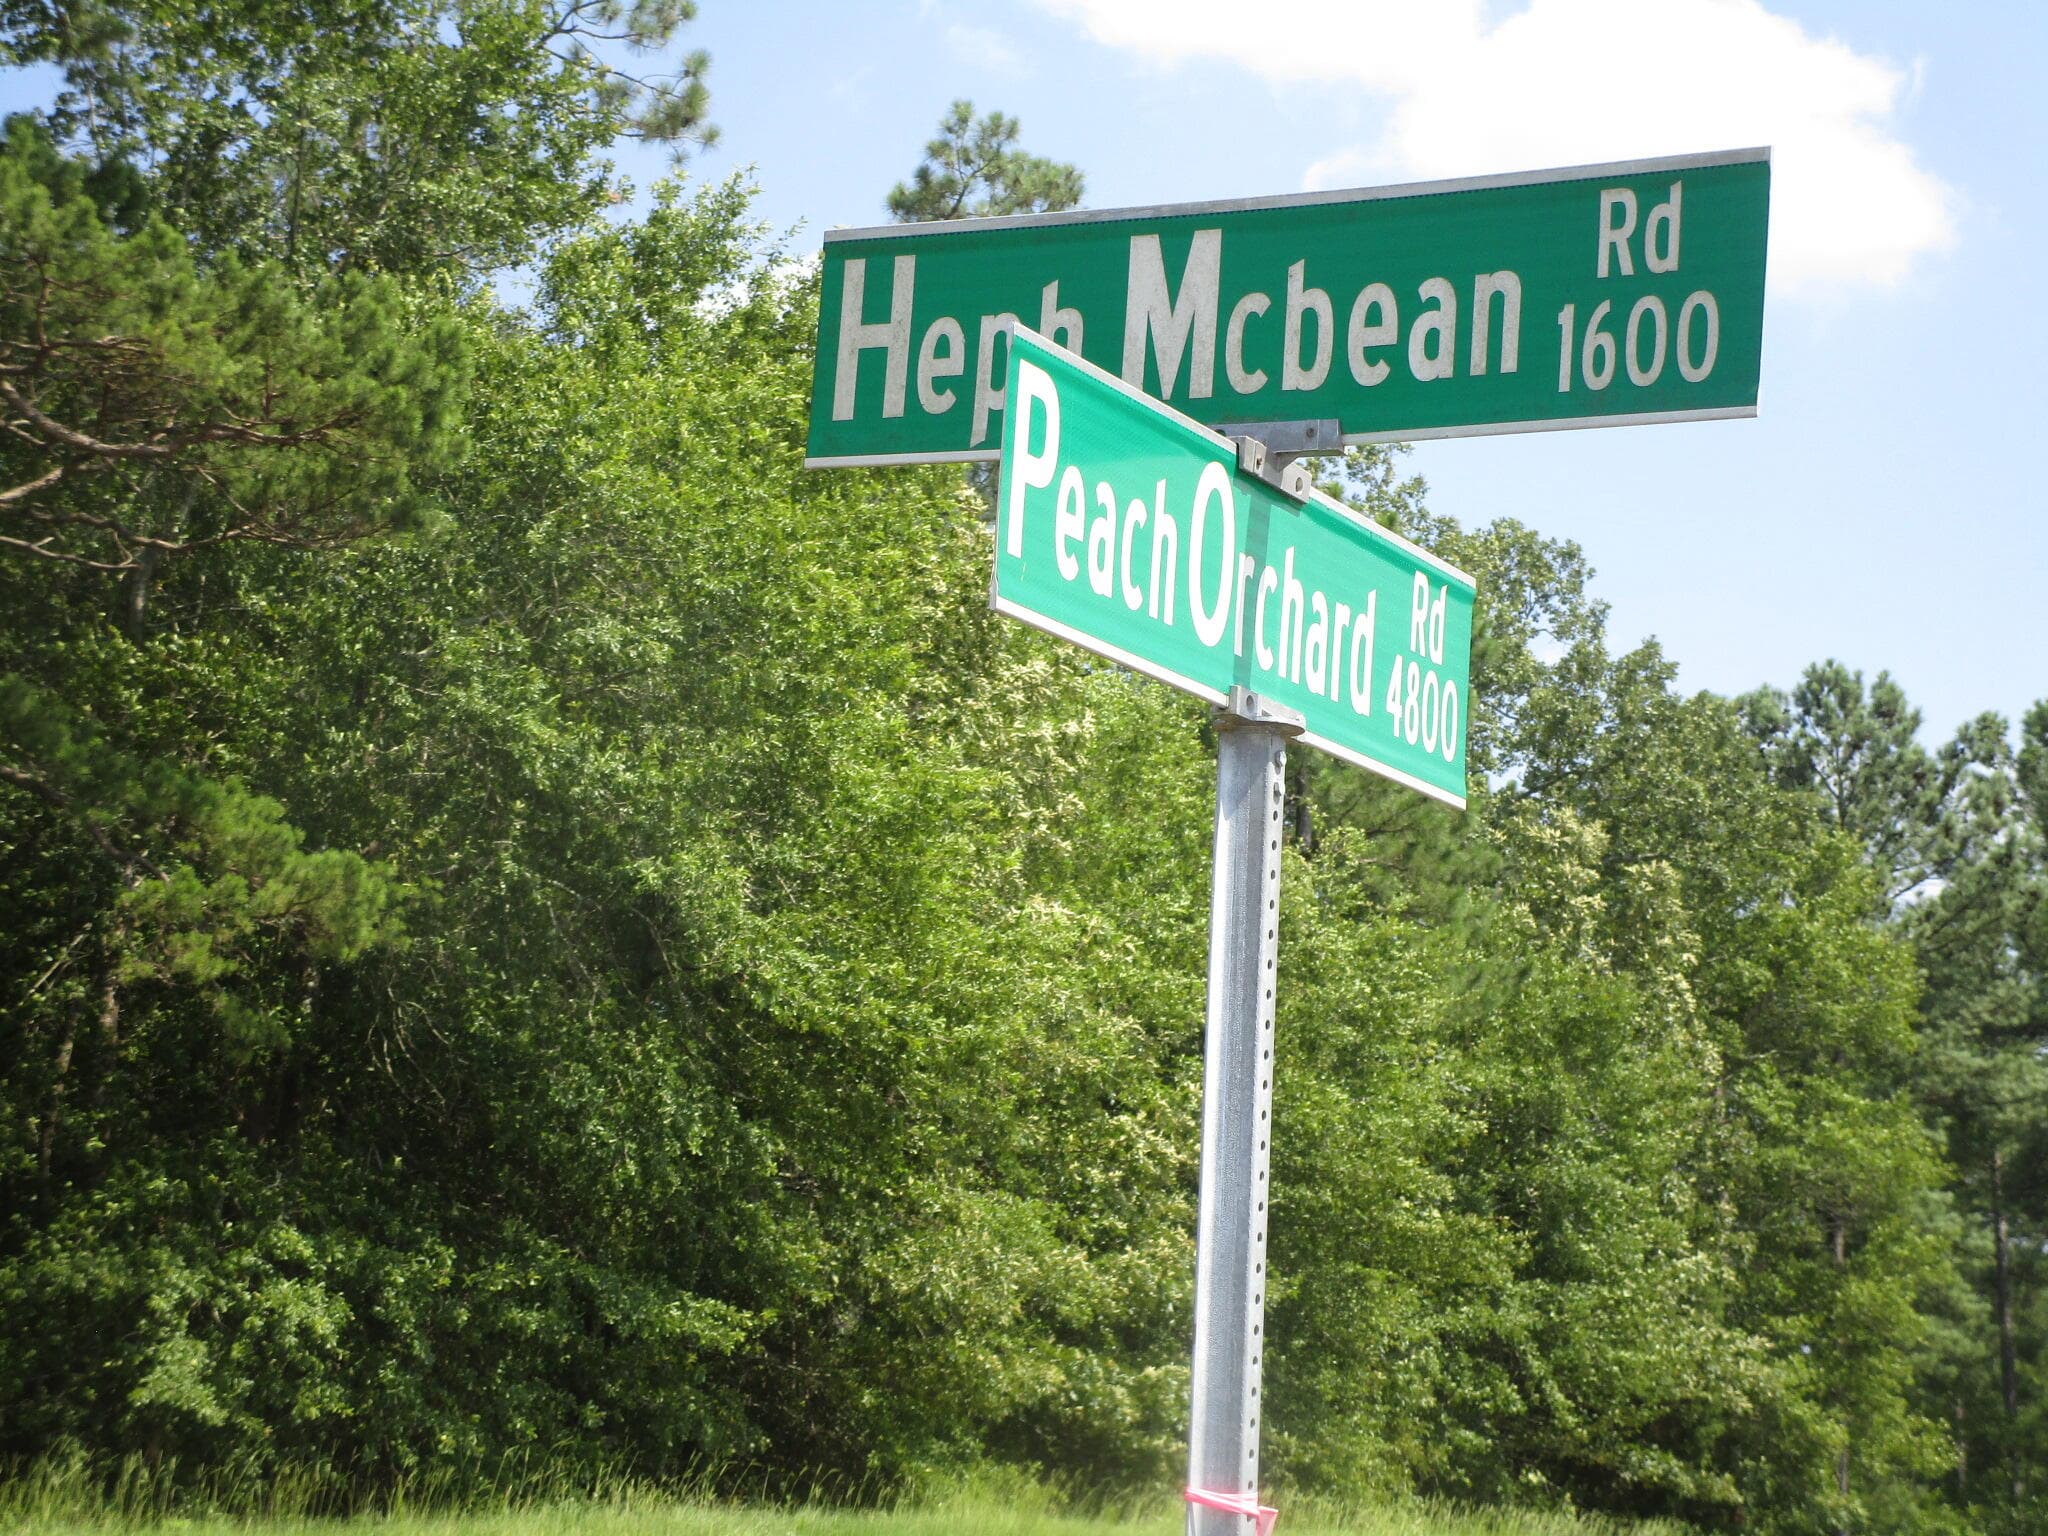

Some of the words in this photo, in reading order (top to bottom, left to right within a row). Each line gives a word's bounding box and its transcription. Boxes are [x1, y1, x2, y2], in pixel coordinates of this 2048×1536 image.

[1597, 179, 1682, 279] Rd
[1121, 228, 1522, 401] Mcbean
[1557, 290, 1719, 393] 1600
[1006, 358, 1178, 626] Peach
[1188, 460, 1377, 717] Orchard
[1409, 570, 1448, 666] Rd
[1385, 654, 1458, 763] 4800
